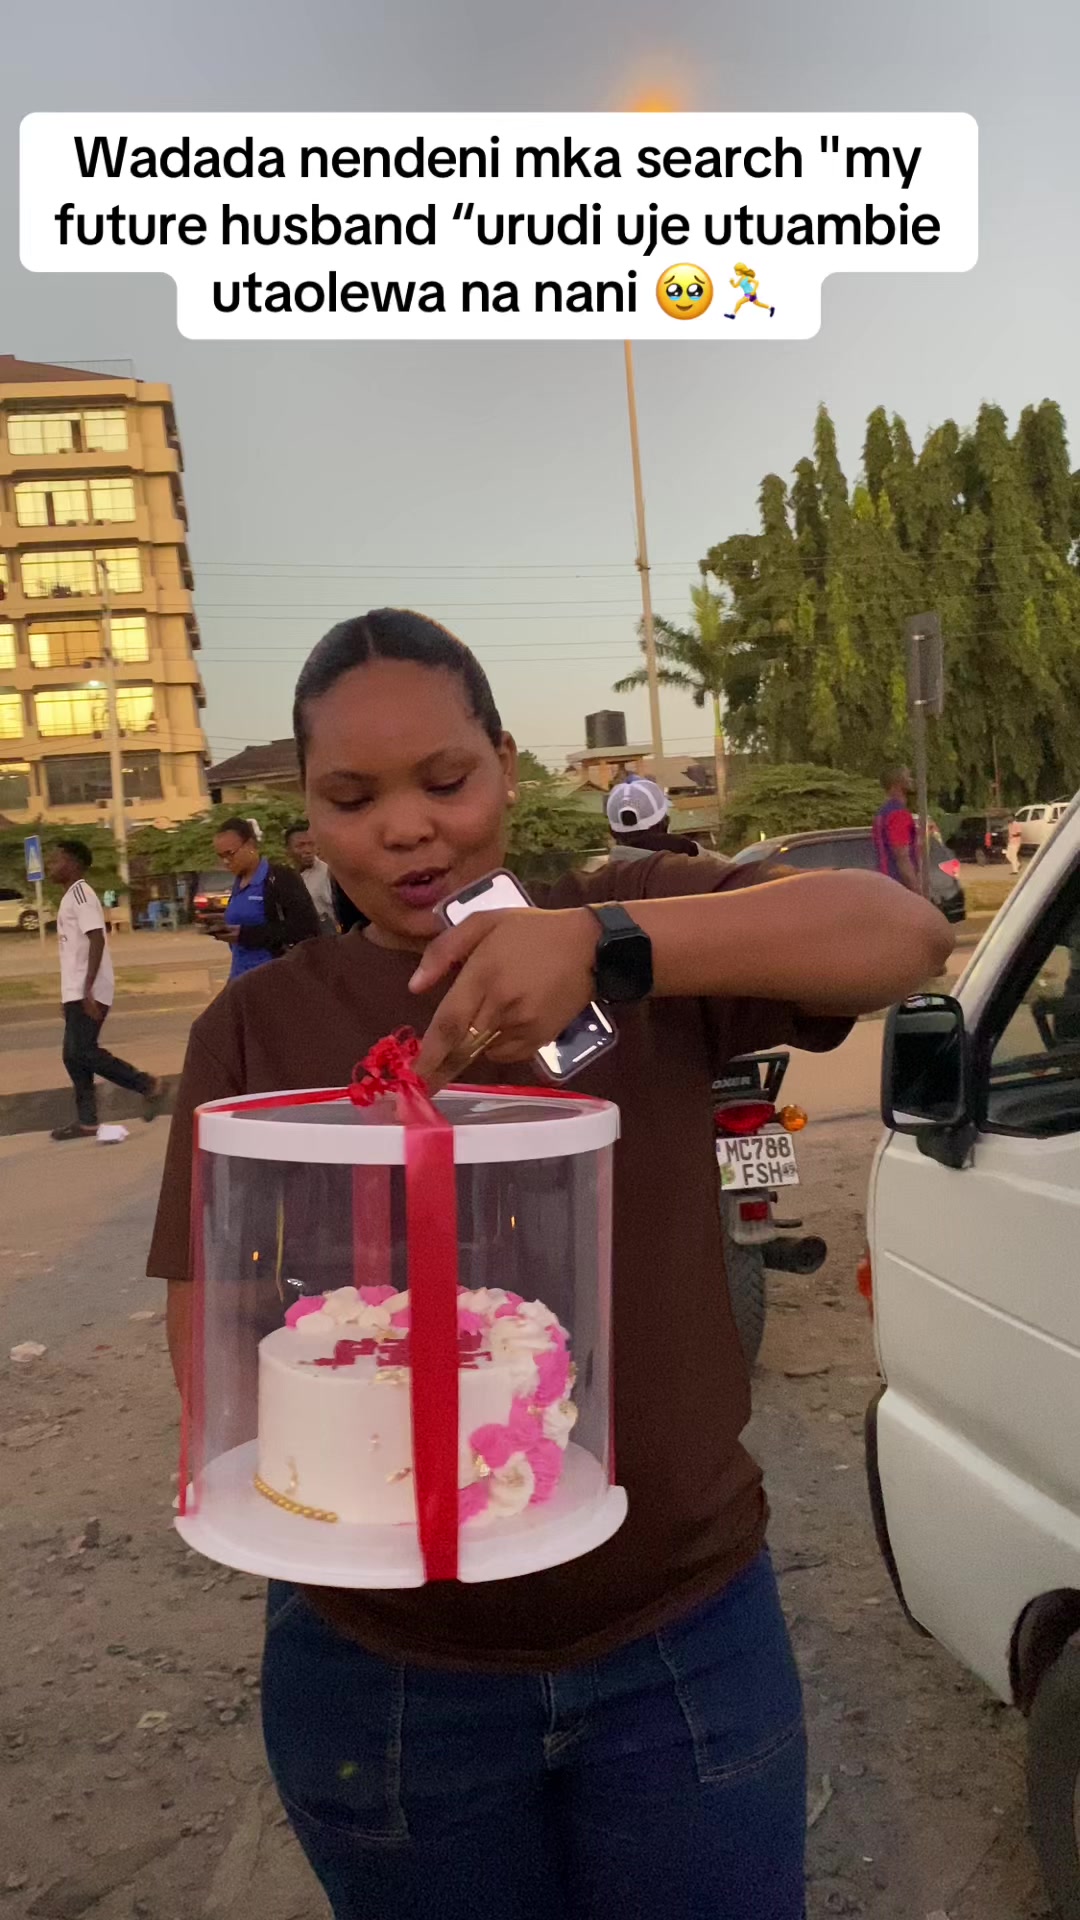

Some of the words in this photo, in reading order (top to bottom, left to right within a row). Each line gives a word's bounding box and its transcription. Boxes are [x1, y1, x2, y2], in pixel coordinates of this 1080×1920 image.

[711, 1076, 751, 1089] OXER
[725, 1137, 791, 1163] MC788
[742, 1162, 783, 1185] FSH
